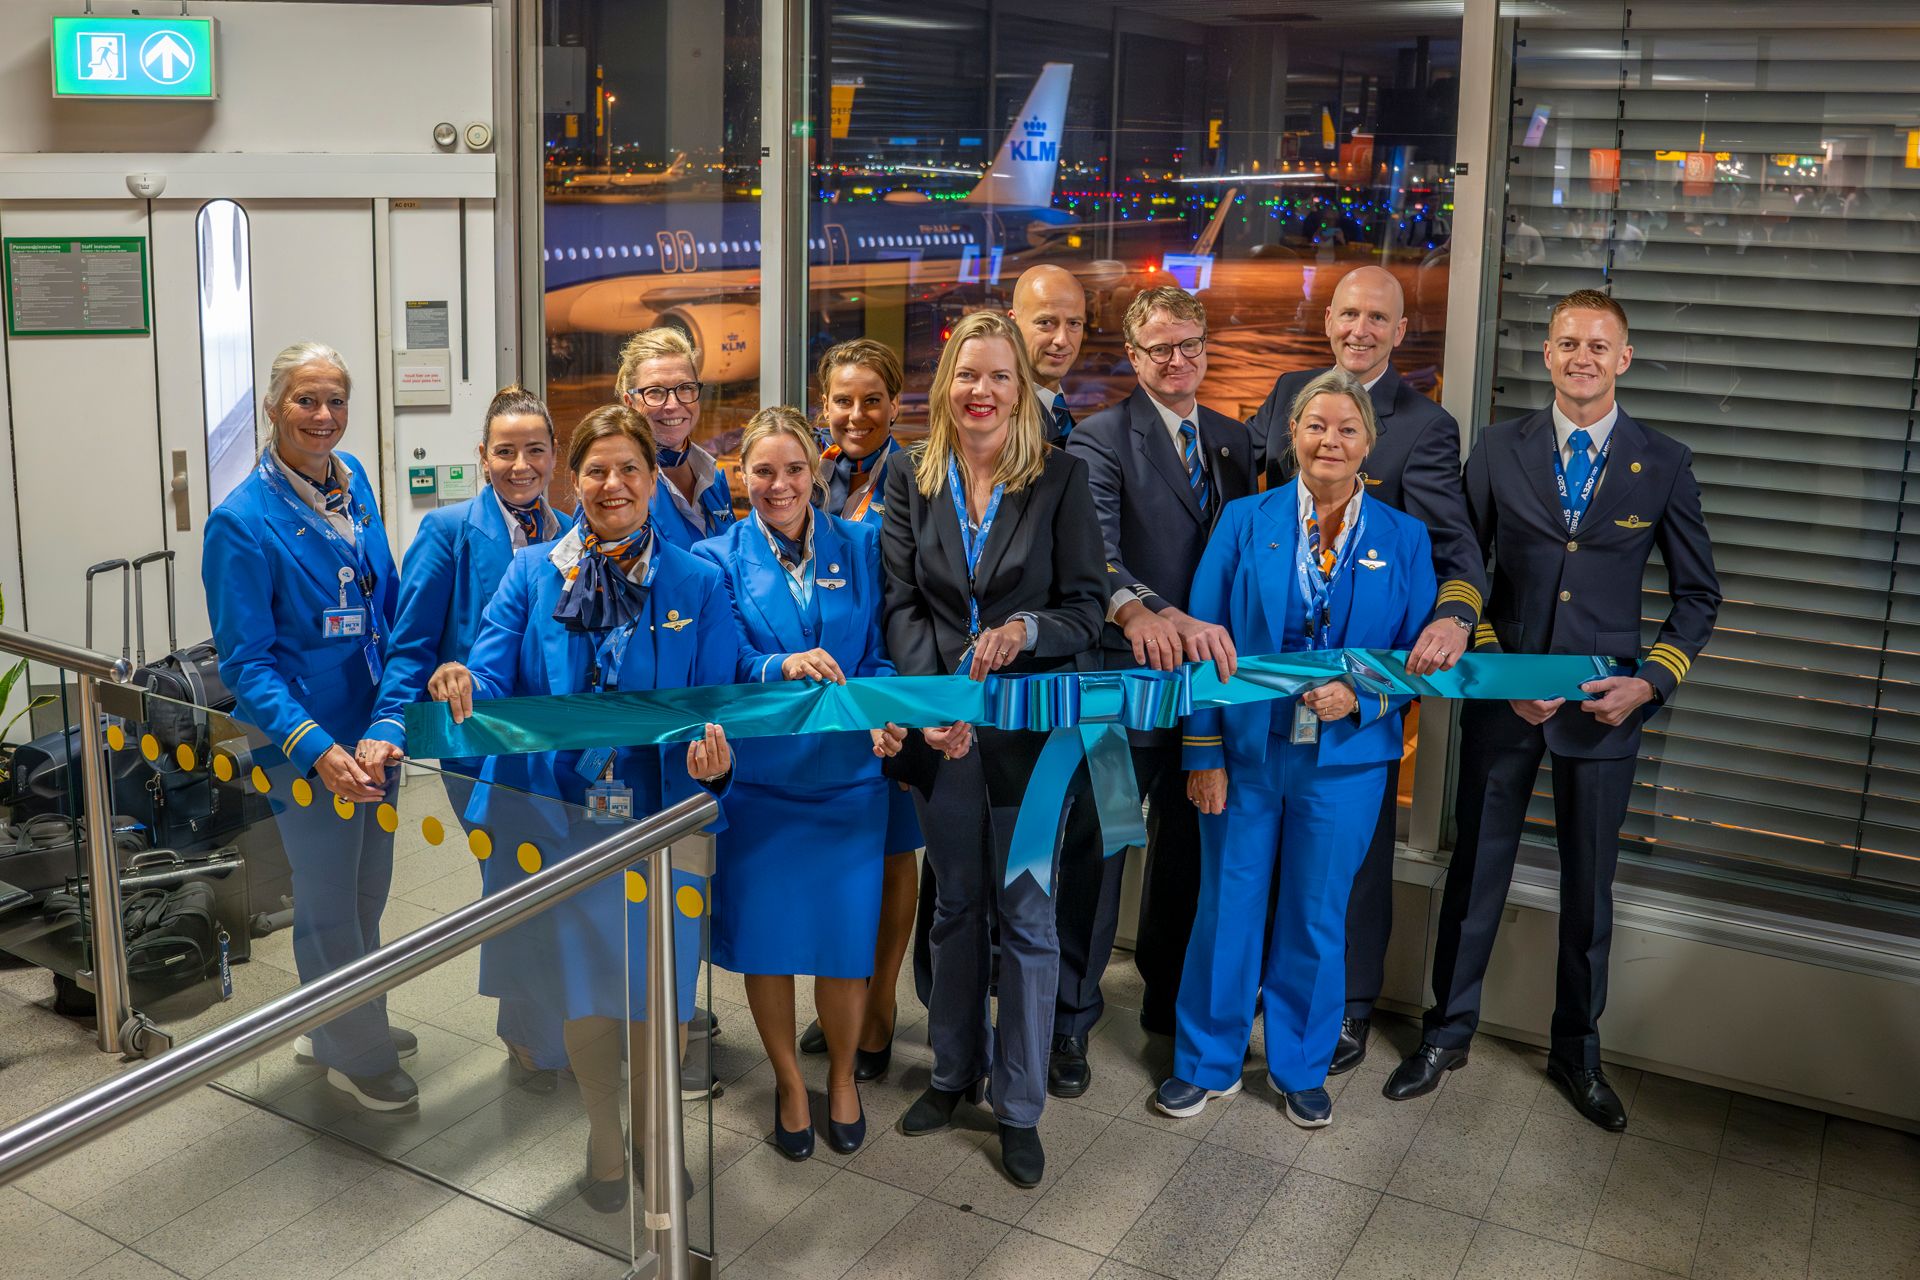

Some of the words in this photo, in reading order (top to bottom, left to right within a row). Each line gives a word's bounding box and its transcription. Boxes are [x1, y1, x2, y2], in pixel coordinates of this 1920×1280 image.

[1010, 140, 1057, 162] KLM
[721, 340, 747, 352] KLM
[222, 951, 231, 987] AIRBUS
